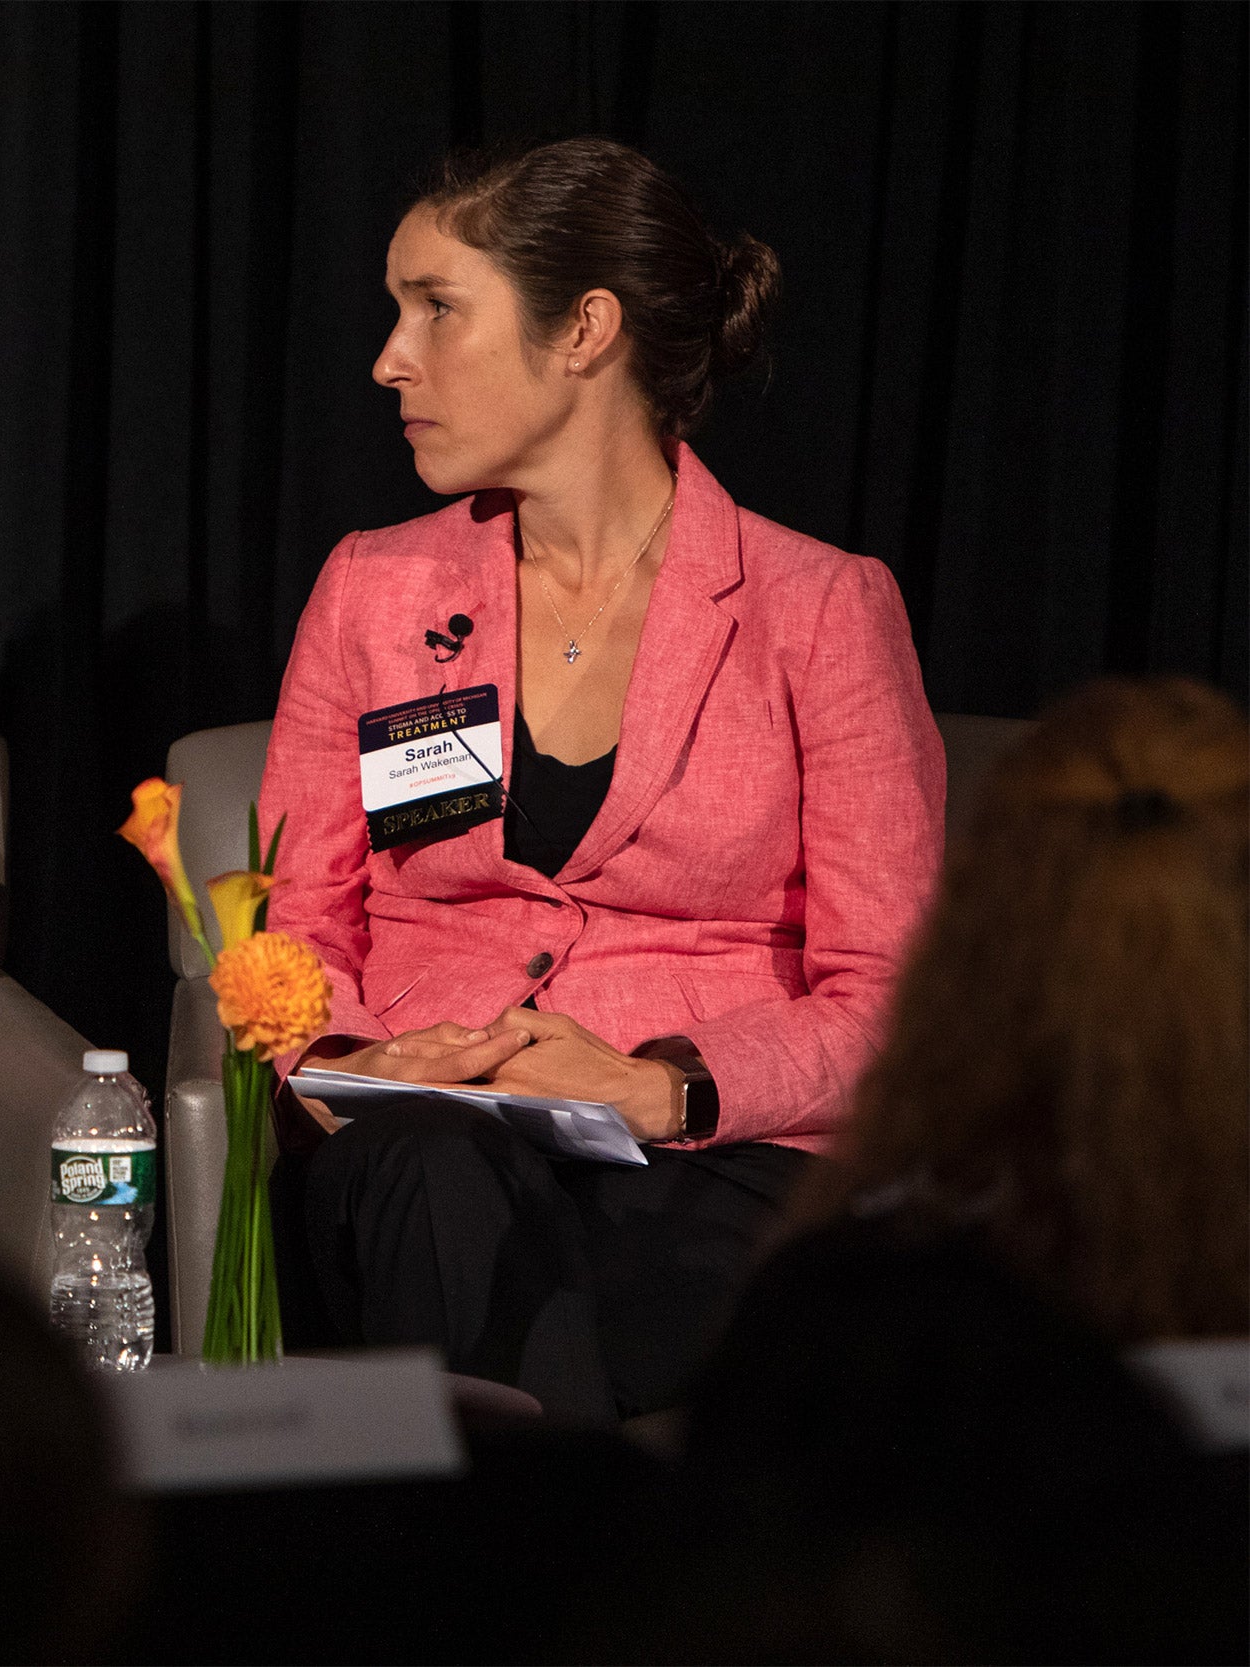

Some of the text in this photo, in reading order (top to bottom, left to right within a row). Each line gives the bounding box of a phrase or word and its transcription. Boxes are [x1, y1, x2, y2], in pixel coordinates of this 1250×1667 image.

[388, 720, 413, 731] STIGMA
[413, 716, 429, 724] AND
[429, 709, 456, 721] ACCSS
[388, 715, 467, 741] TREATMENT
[405, 740, 453, 762] Sarah
[388, 752, 472, 779] Sarah Wakeman
[384, 793, 490, 835] SPEAKER
[60, 1157, 103, 1179] Poland
[61, 1174, 106, 1195] Spring
